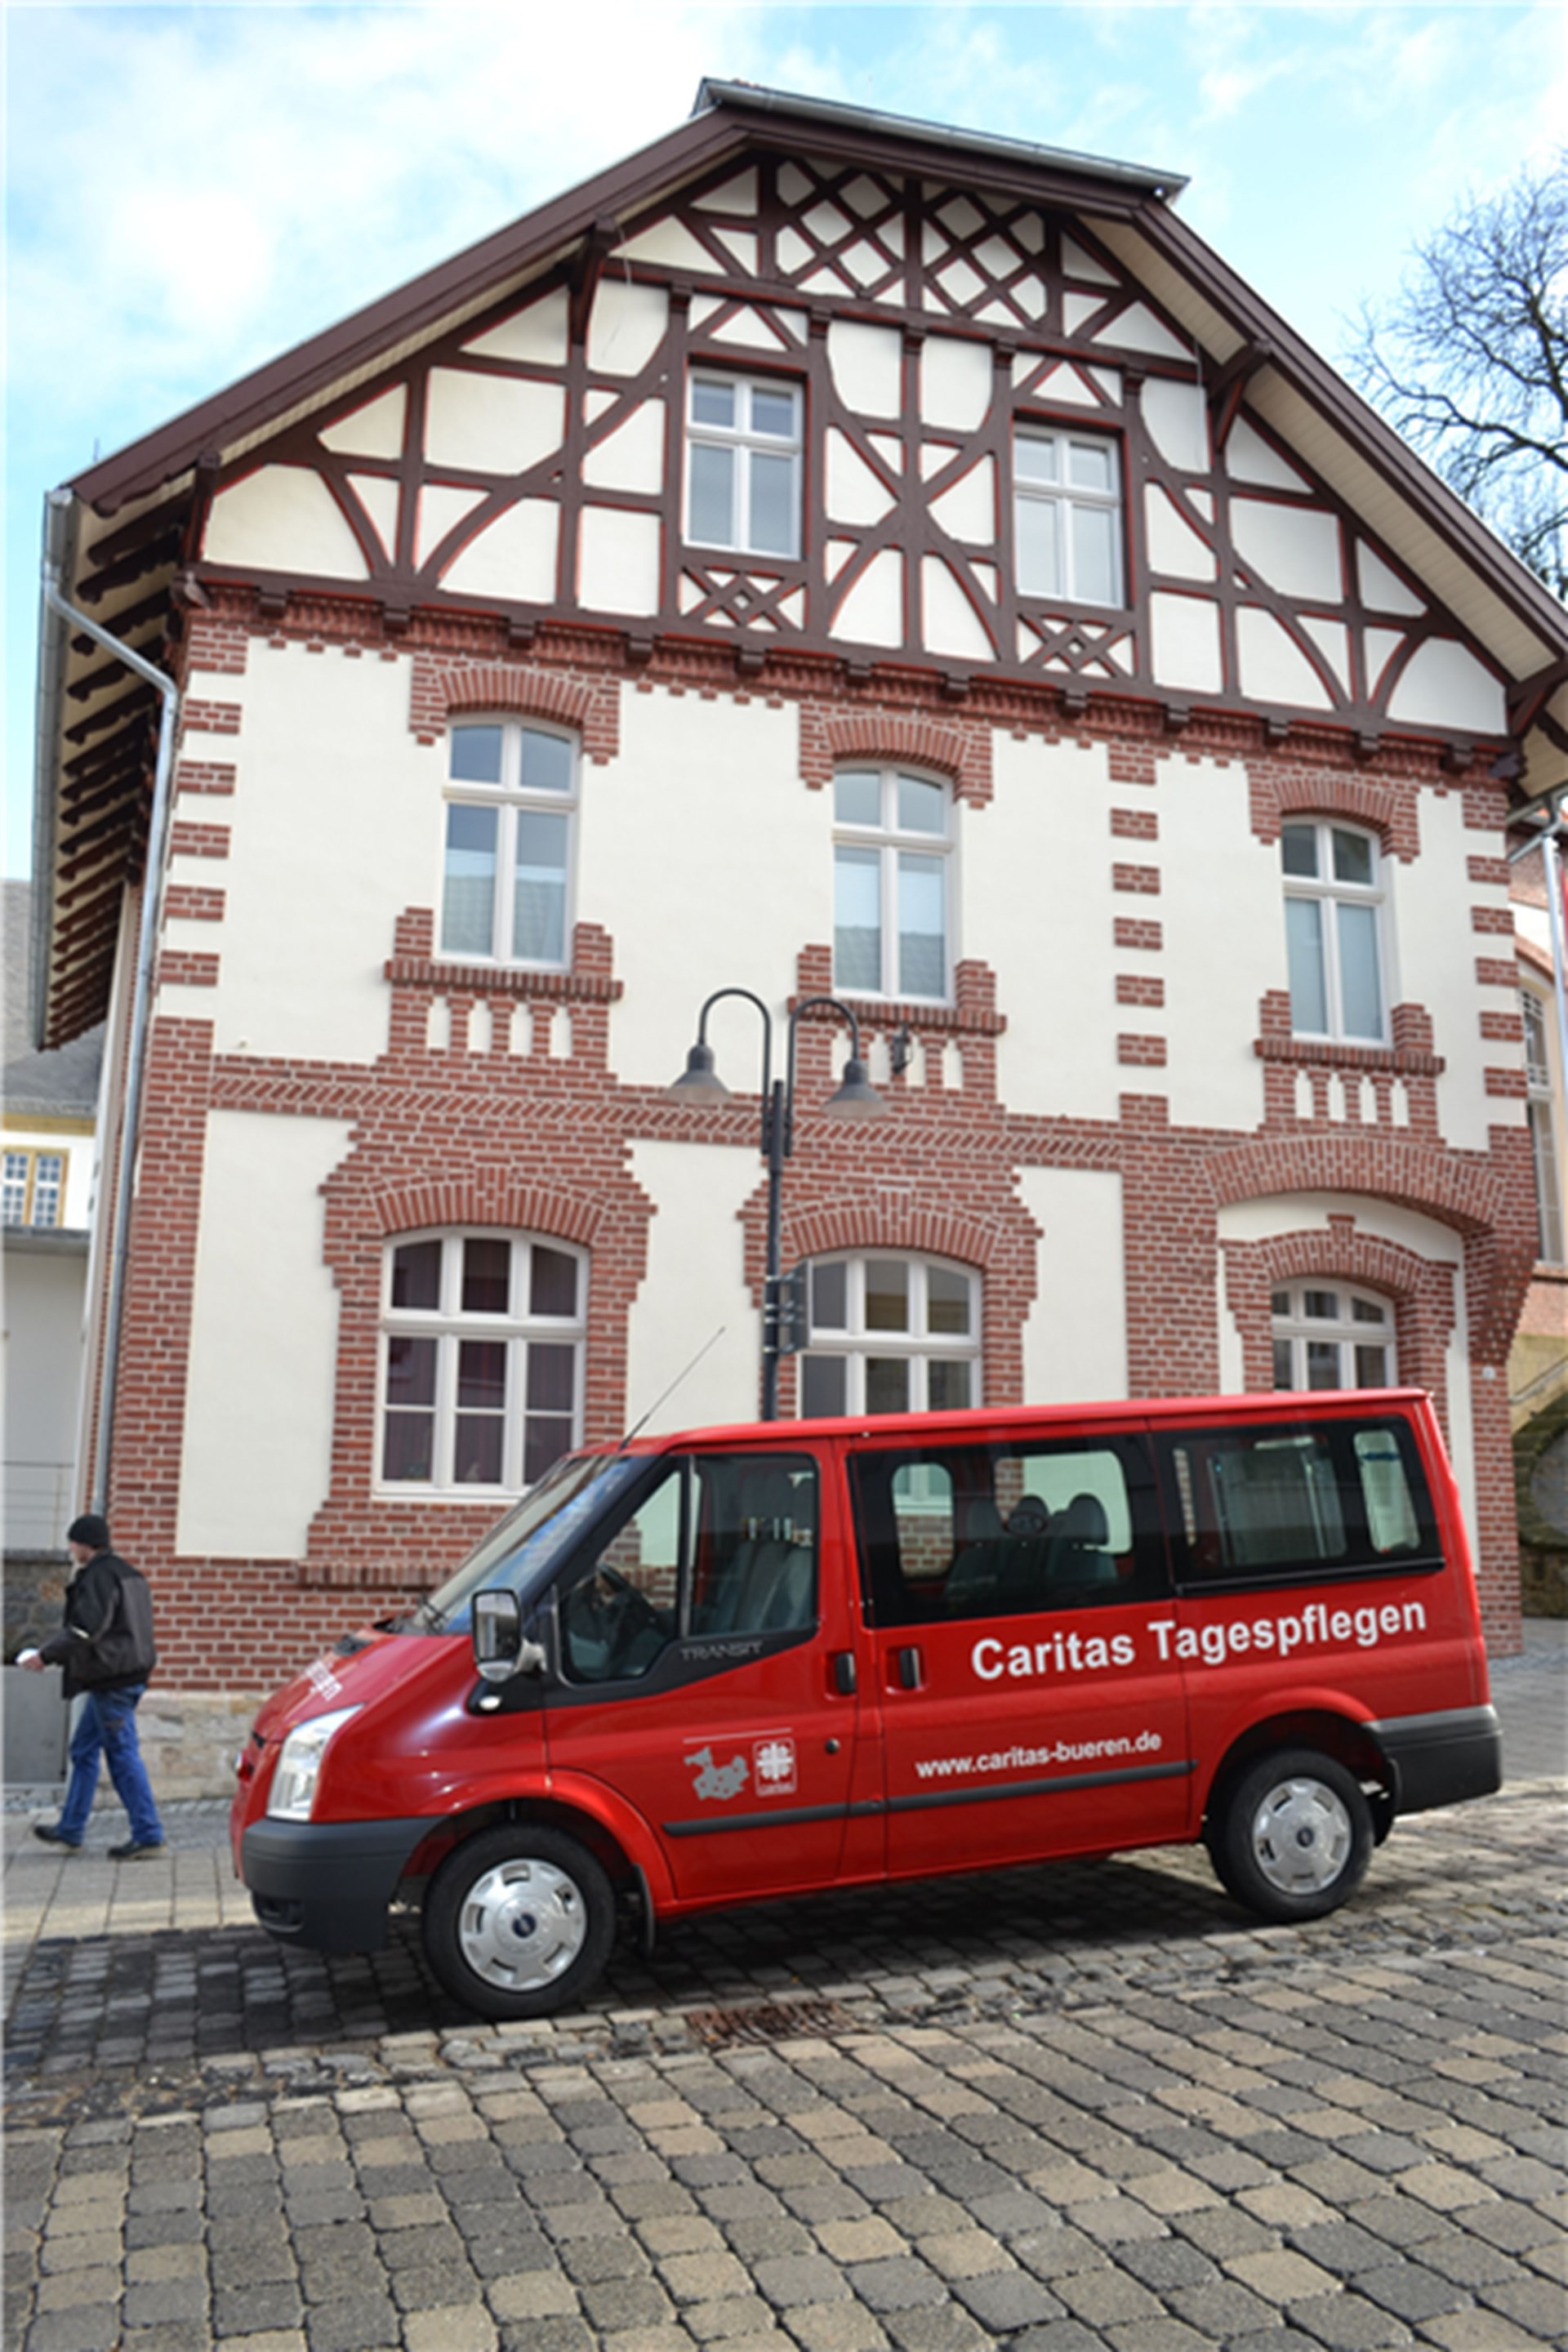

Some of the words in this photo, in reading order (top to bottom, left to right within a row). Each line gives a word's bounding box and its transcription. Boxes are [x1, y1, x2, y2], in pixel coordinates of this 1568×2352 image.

[679, 1641, 763, 1661] TRANSIT
[972, 1632, 1135, 1680] Caritas
[1147, 1602, 1427, 1665] Tagespflegen
[915, 1731, 1161, 1779] www.caritas-bueren.de
